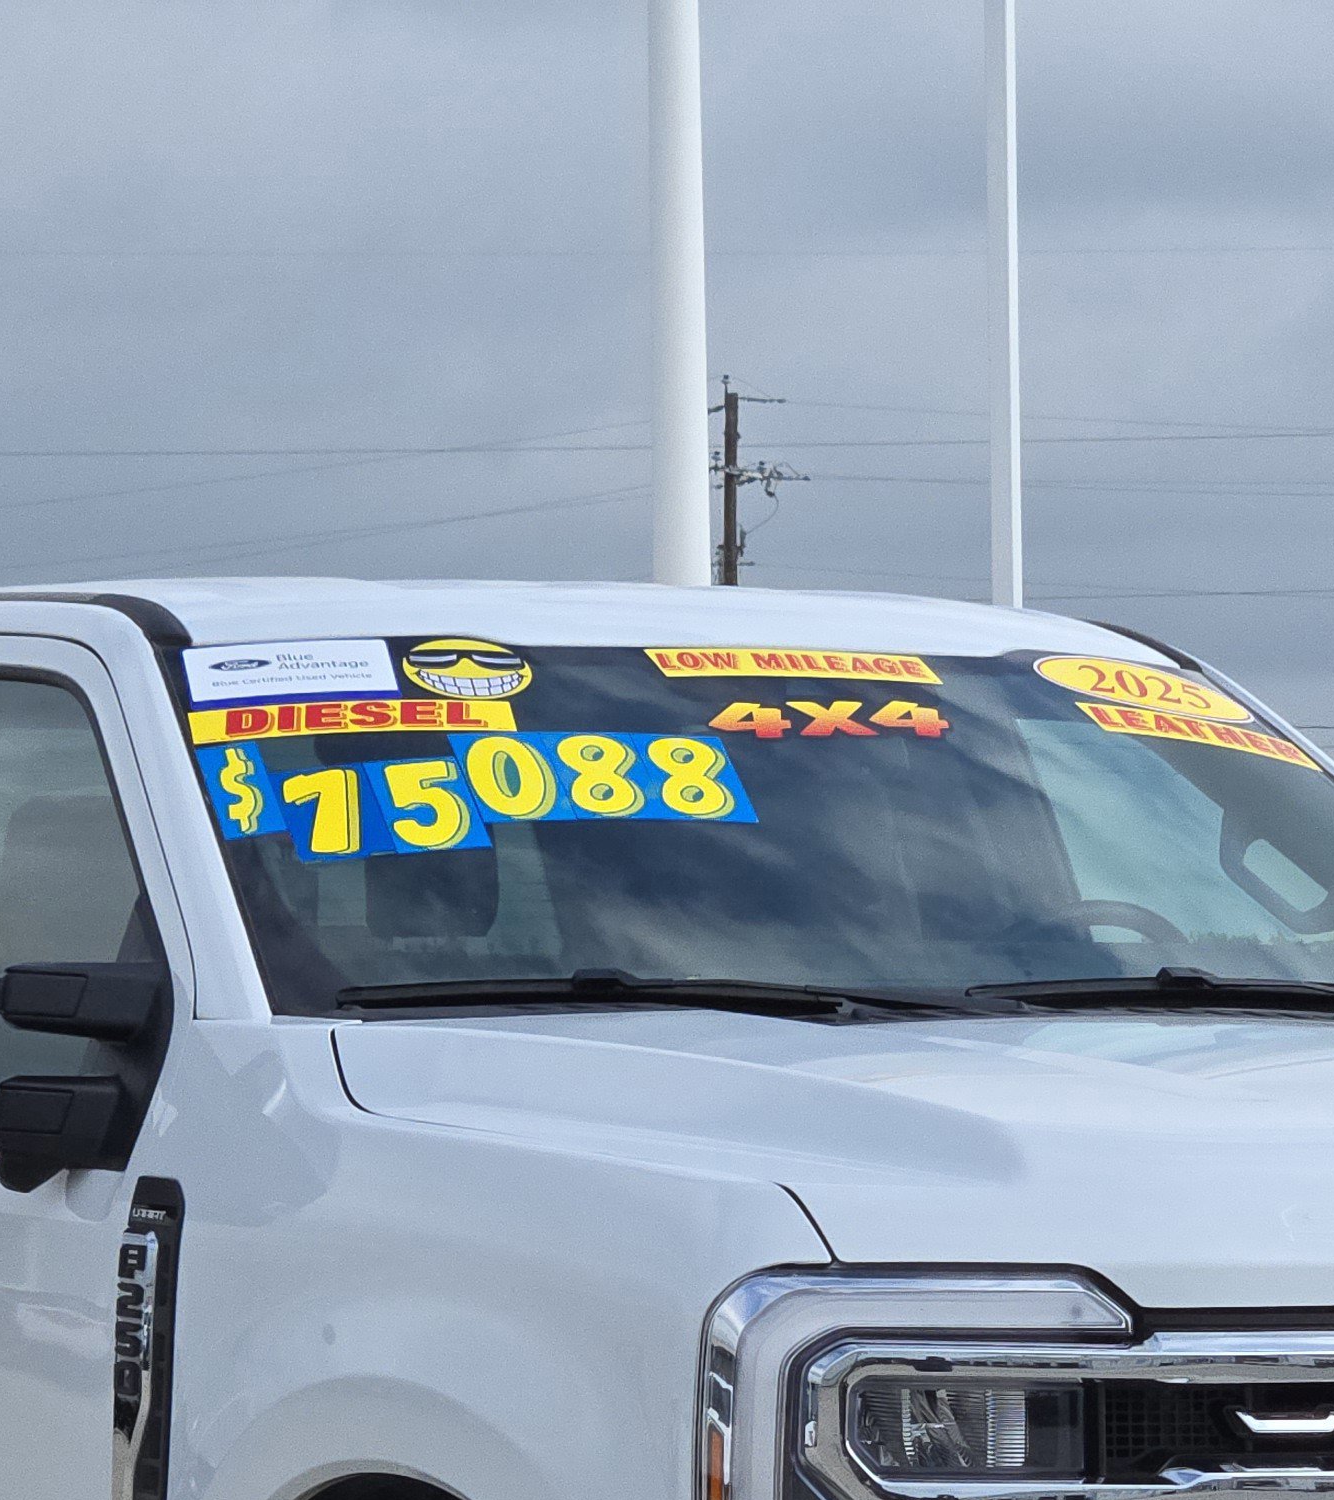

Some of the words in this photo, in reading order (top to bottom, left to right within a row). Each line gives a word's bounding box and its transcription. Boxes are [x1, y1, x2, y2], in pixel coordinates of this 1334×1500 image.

[276, 653, 314, 662] Blue
[278, 660, 369, 671] Advantage
[655, 652, 739, 671] LOW
[751, 653, 927, 676] MILEAGE
[1078, 664, 1212, 710] 2025
[225, 702, 488, 737] DIESEL
[708, 700, 950, 738] 4X4
[1089, 706, 1305, 762] LEATHER
